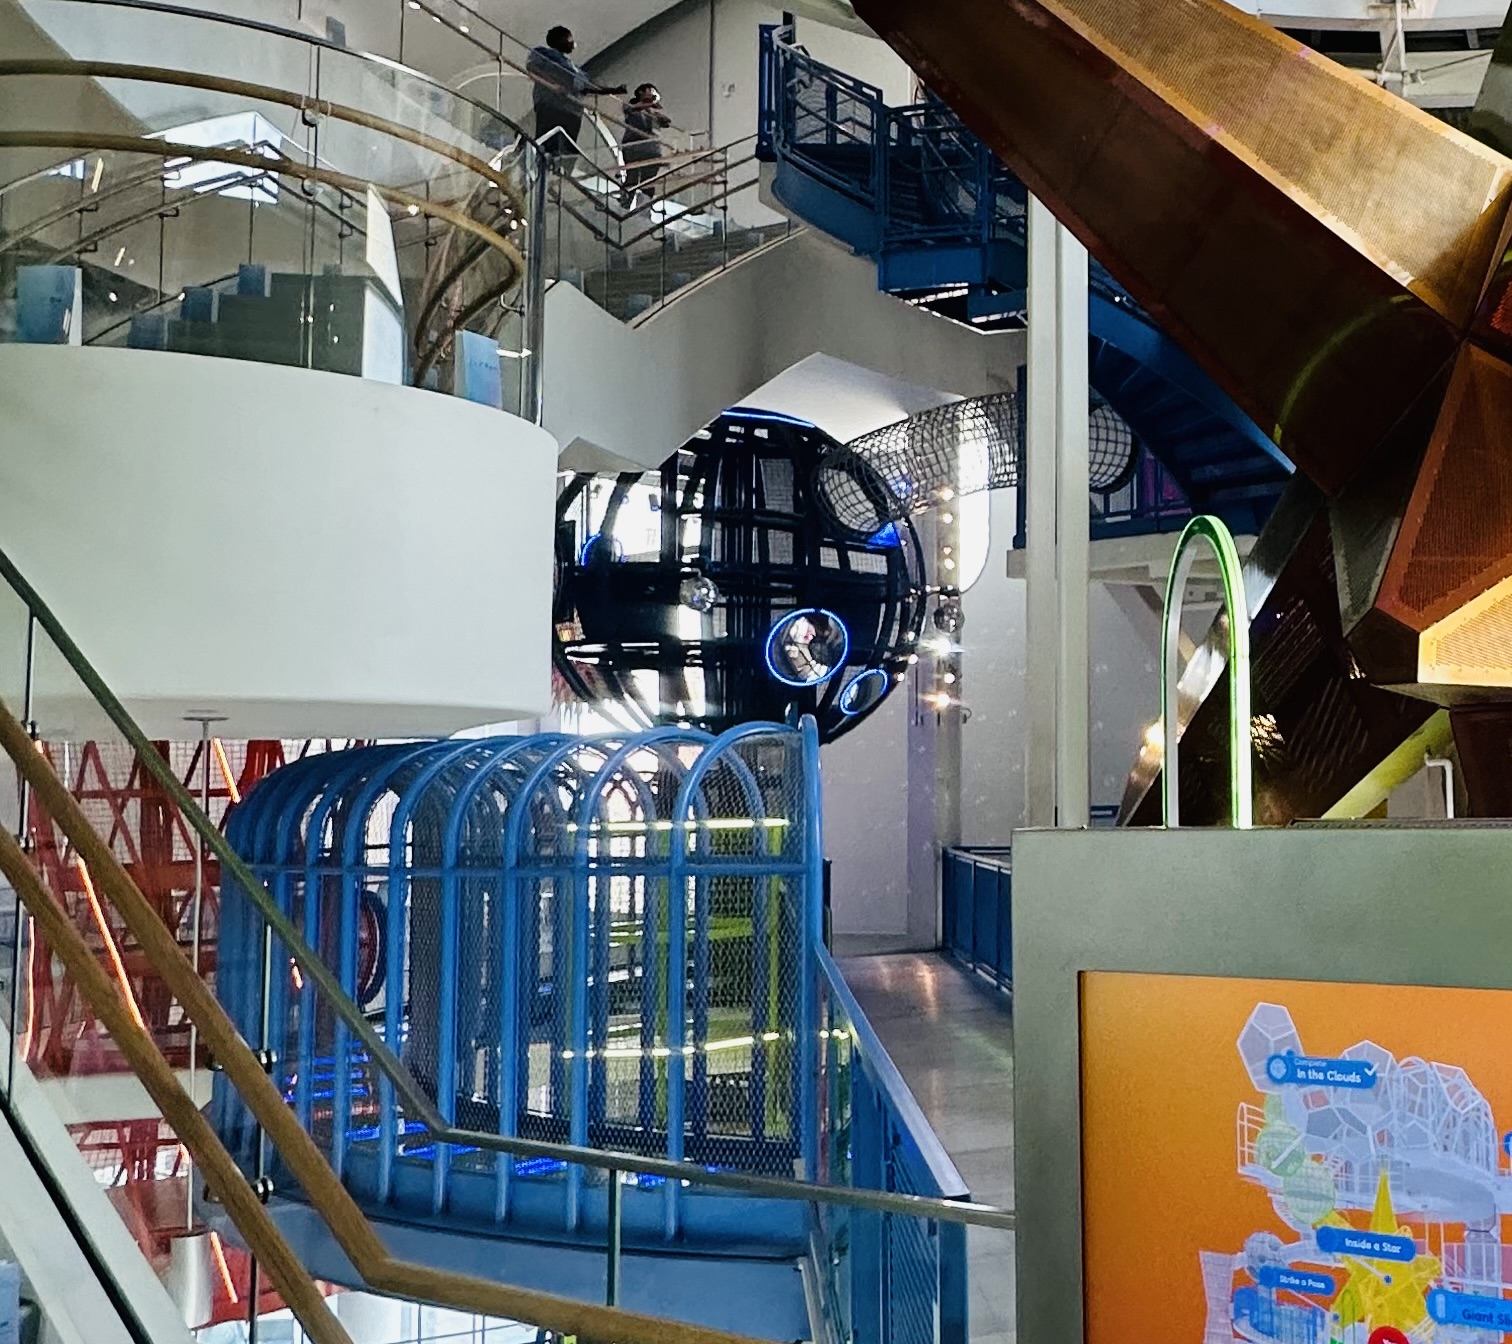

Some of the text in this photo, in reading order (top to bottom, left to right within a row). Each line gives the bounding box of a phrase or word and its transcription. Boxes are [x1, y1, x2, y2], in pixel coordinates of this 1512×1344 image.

[1297, 1068, 1361, 1083] In the Clouds
[1345, 1238, 1402, 1254] Inside a Star
[1462, 1308, 1494, 1324] Giant
